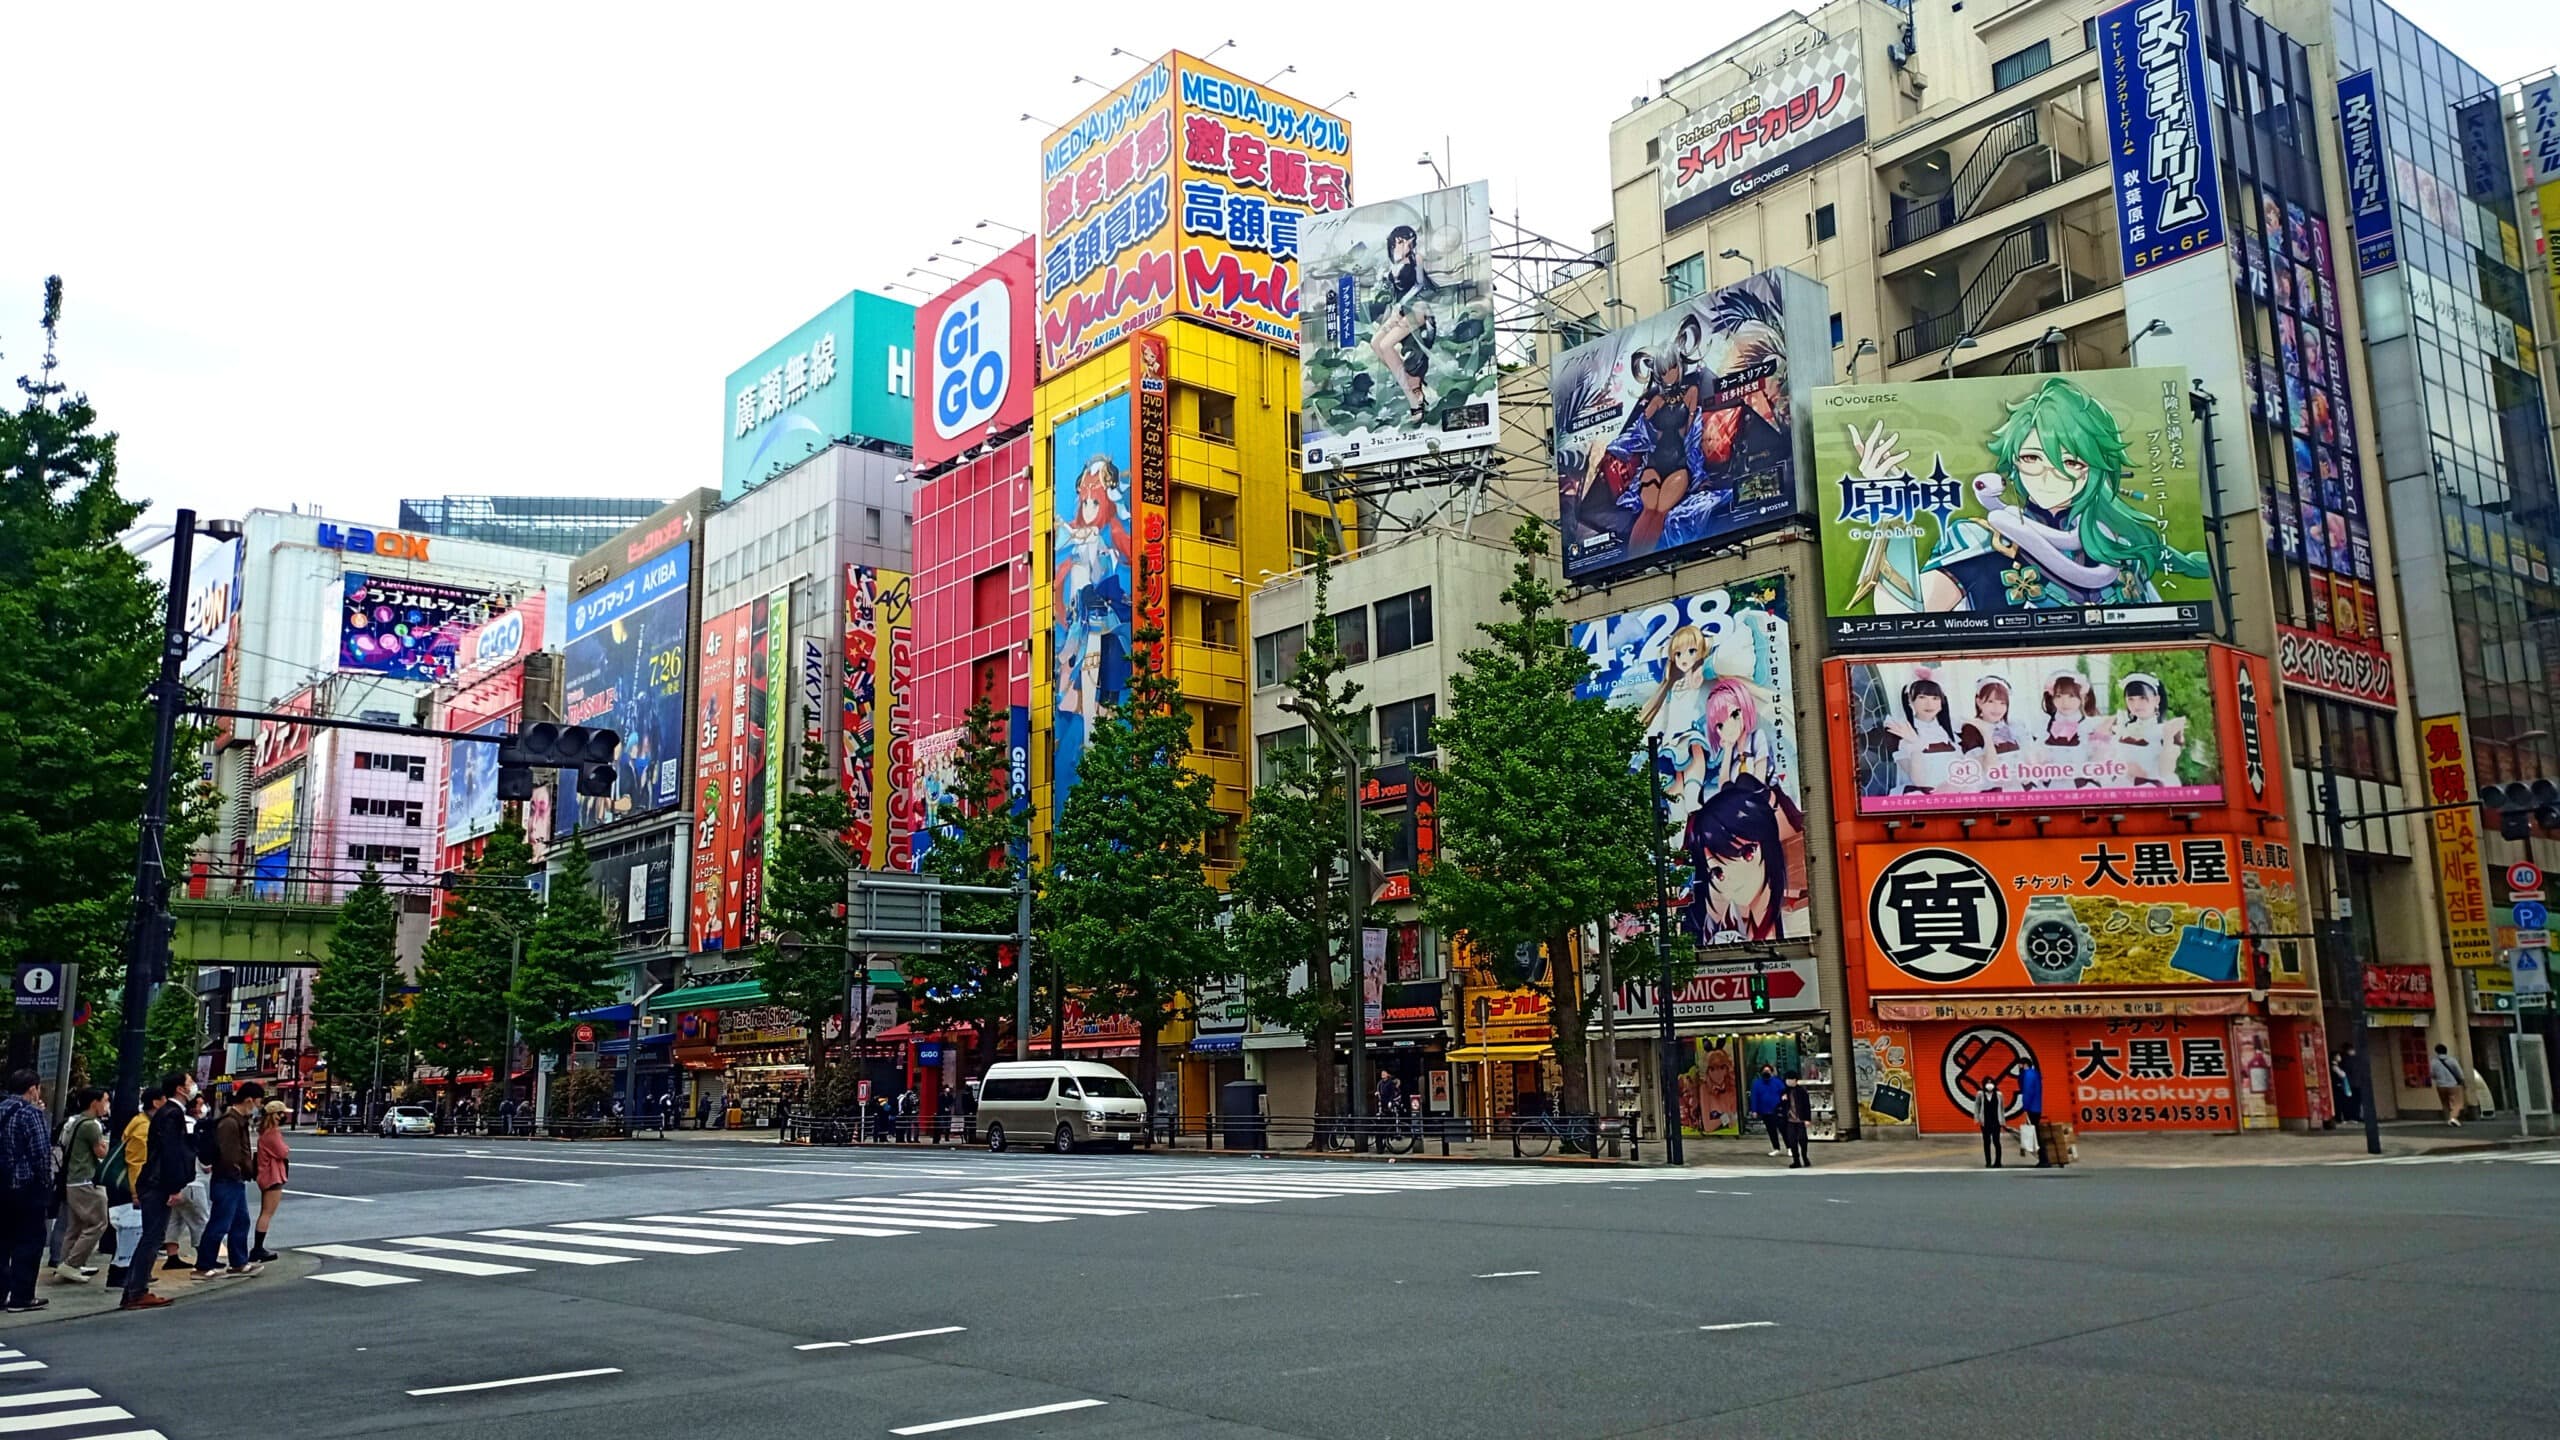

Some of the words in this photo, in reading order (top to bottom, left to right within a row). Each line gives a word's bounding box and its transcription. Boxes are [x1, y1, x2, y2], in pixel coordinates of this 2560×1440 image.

[1677, 73, 1846, 188] メイドカジノ
[1046, 110, 1168, 237] 激安販売
[1184, 116, 1349, 211] 激安販売
[1184, 182, 1303, 257] 高額買
[2123, 169, 2146, 244] 秋葉原店
[1045, 175, 1168, 301] 高額買取
[1203, 304, 1255, 329] ムーラン
[1255, 320, 1293, 341] AKIBA
[1057, 341, 1093, 368] ムーラン
[1093, 327, 1121, 349] AKIBA
[1720, 366, 1771, 390] カーネリアン
[1143, 394, 1162, 407] DVD
[1143, 419, 1163, 431] ゲーム
[1146, 431, 1160, 442] CD
[2162, 380, 2185, 470] 冒険に満ちた
[1143, 443, 1163, 455] アイドル
[1143, 455, 1163, 467] アニメ
[1143, 468, 1163, 479] コミック
[1144, 481, 1163, 490] ホビー
[1836, 453, 1962, 542] 原神
[2147, 430, 2177, 590] ブランニューワールドへ
[1850, 526, 1925, 541] Genshin
[587, 580, 635, 621] ソフマップ
[642, 560, 677, 593] AKIBA
[1856, 620, 1892, 632] PS5
[1901, 618, 1938, 631] PS4
[1944, 616, 1990, 630] Windows
[706, 632, 722, 657] 4F
[805, 640, 822, 704] AKKY
[2281, 632, 2389, 698] メイドカジノ
[1586, 683, 1602, 694] FRI
[1628, 672, 1655, 685] SALE
[701, 721, 718, 749] 3F
[1987, 764, 2008, 780] at
[2017, 762, 2074, 780] home
[2082, 759, 2128, 778] cafe
[698, 821, 714, 849] 2F
[2458, 809, 2475, 855] TAX
[2013, 874, 2074, 891] チケット
[2081, 840, 2231, 890] 大黒屋
[2436, 812, 2467, 923] 면세점
[2515, 870, 2534, 884] 40
[2463, 863, 2486, 922] FREE
[1884, 867, 1996, 968] 質
[2520, 909, 2533, 928] P
[1717, 965, 1746, 975] Magazine
[768, 1008, 791, 1027] Shop
[869, 1008, 891, 1016] Japan
[920, 1051, 938, 1059] GiGO
[2075, 1038, 2229, 1080] 大黒屋
[2078, 1085, 2232, 1104] Daikokuya
[2081, 1106, 2233, 1124] 03(3254)5351
